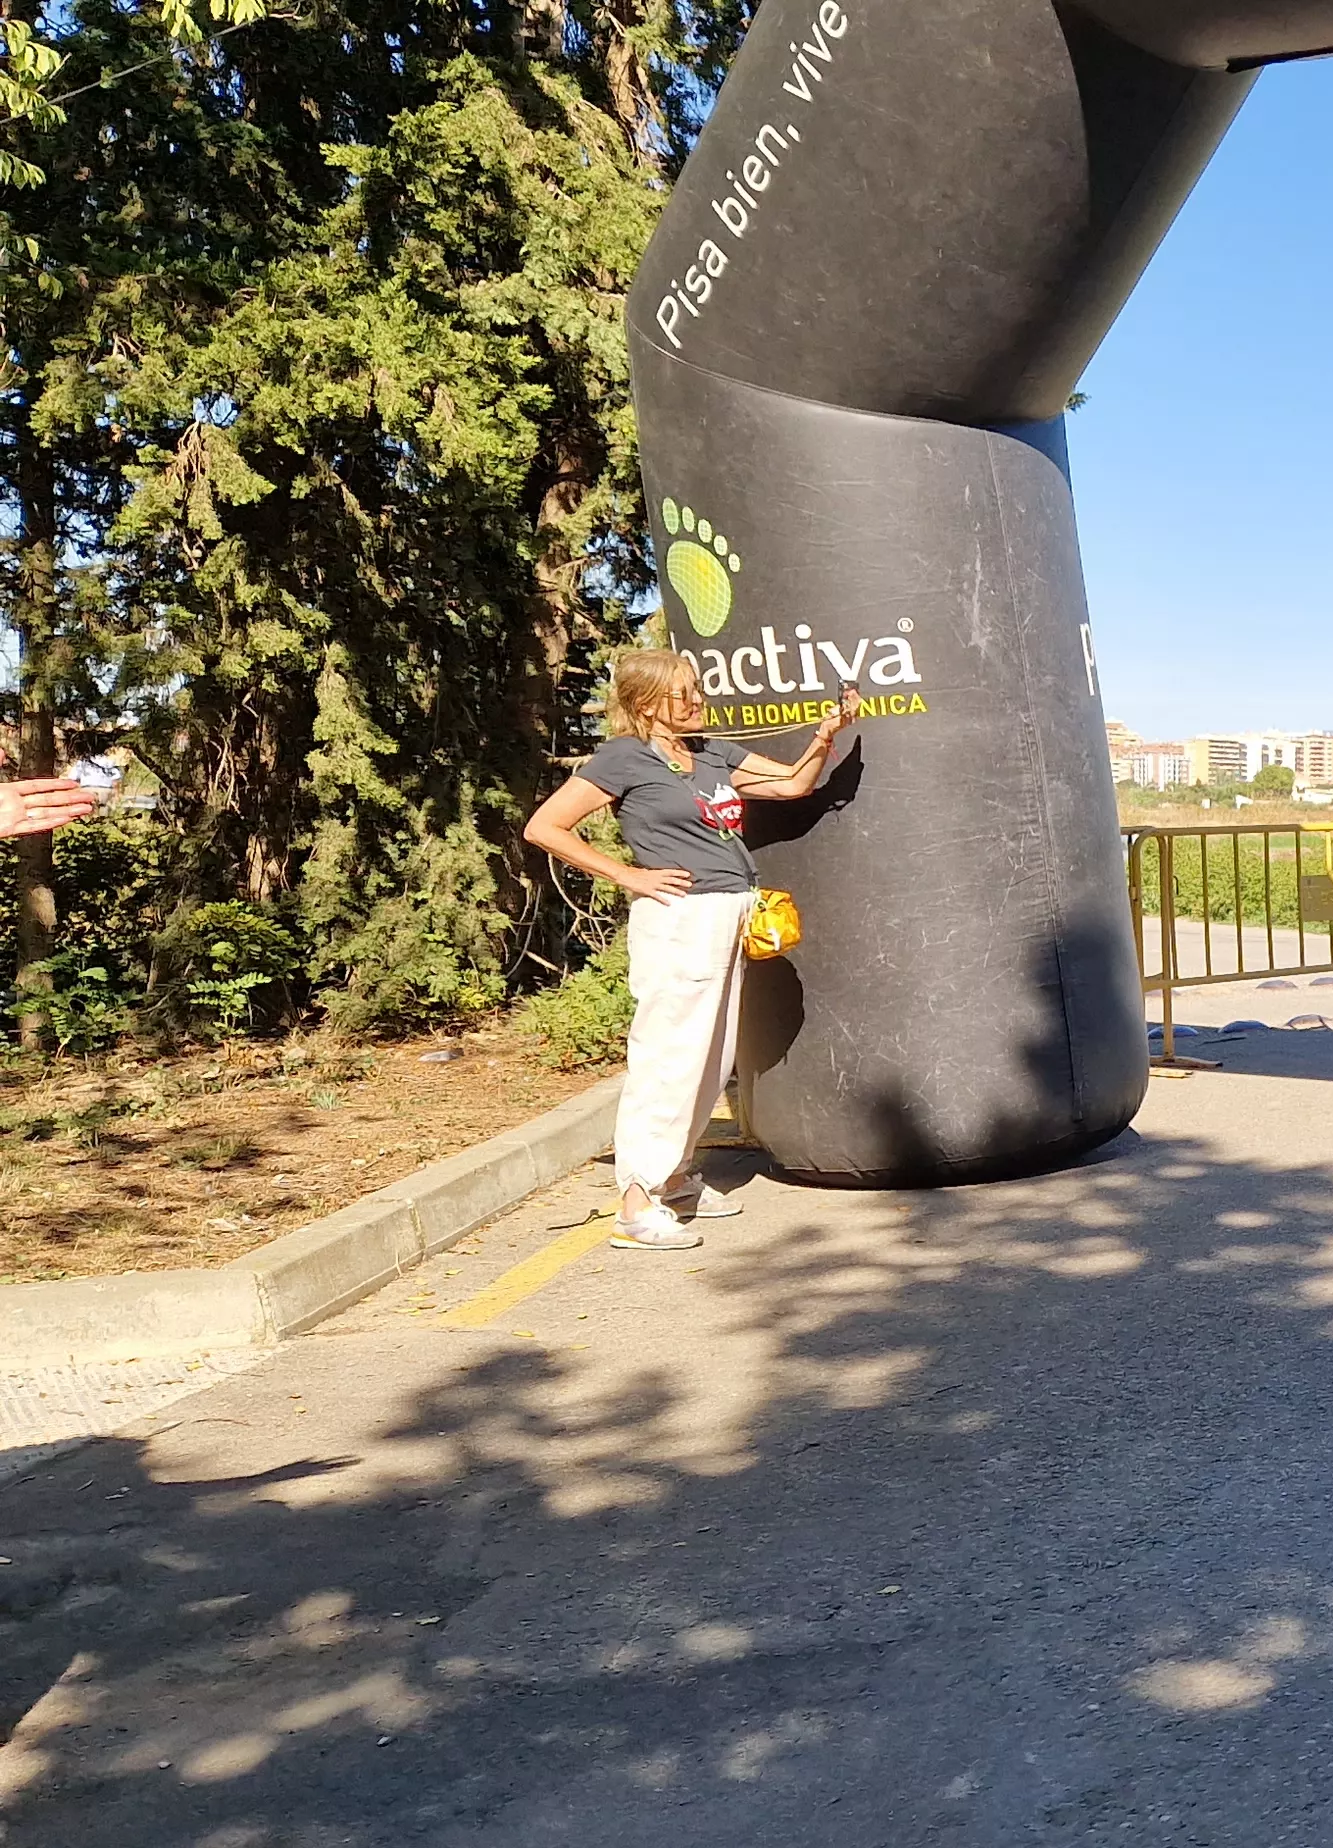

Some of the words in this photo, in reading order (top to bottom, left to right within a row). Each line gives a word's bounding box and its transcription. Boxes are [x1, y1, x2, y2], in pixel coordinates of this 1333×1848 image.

[655, 239, 730, 349] Pisa
[711, 122, 801, 238] bien,
[781, 0, 849, 103] vive
[722, 705, 735, 726] Y
[740, 692, 928, 727] BIOMECNICA
